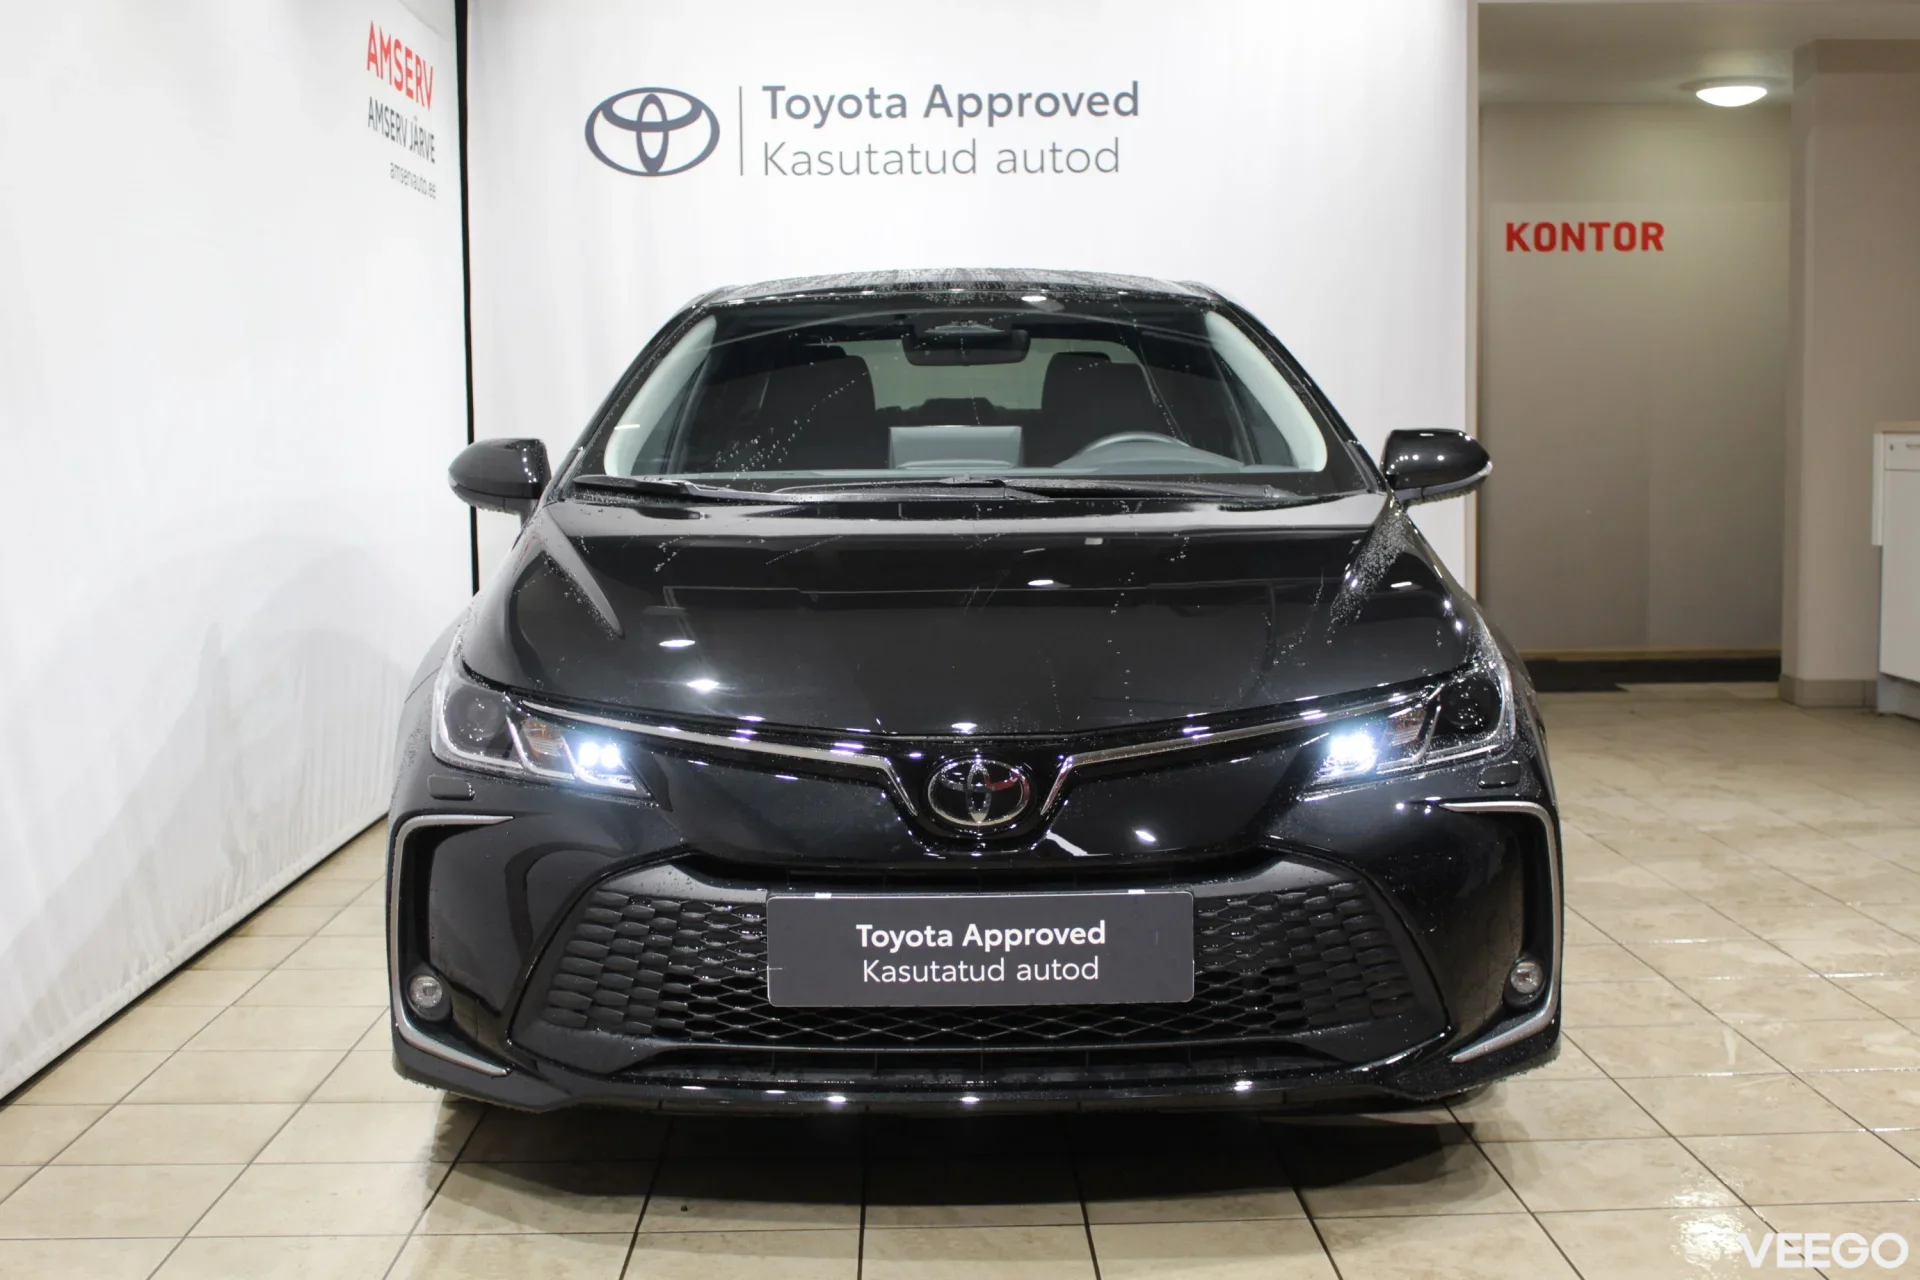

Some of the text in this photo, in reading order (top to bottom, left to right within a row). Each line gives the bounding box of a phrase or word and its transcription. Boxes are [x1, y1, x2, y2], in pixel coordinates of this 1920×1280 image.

[366, 20, 434, 112] AMSERV
[368, 96, 408, 148] AMSERV
[761, 80, 1140, 129] Toyota Approved
[763, 137, 1120, 177] Kasutatud autod
[1505, 221, 1665, 253] KONTOR
[856, 920, 1106, 953] Toyota Approved
[863, 955, 1100, 983] Kasutatud autod
